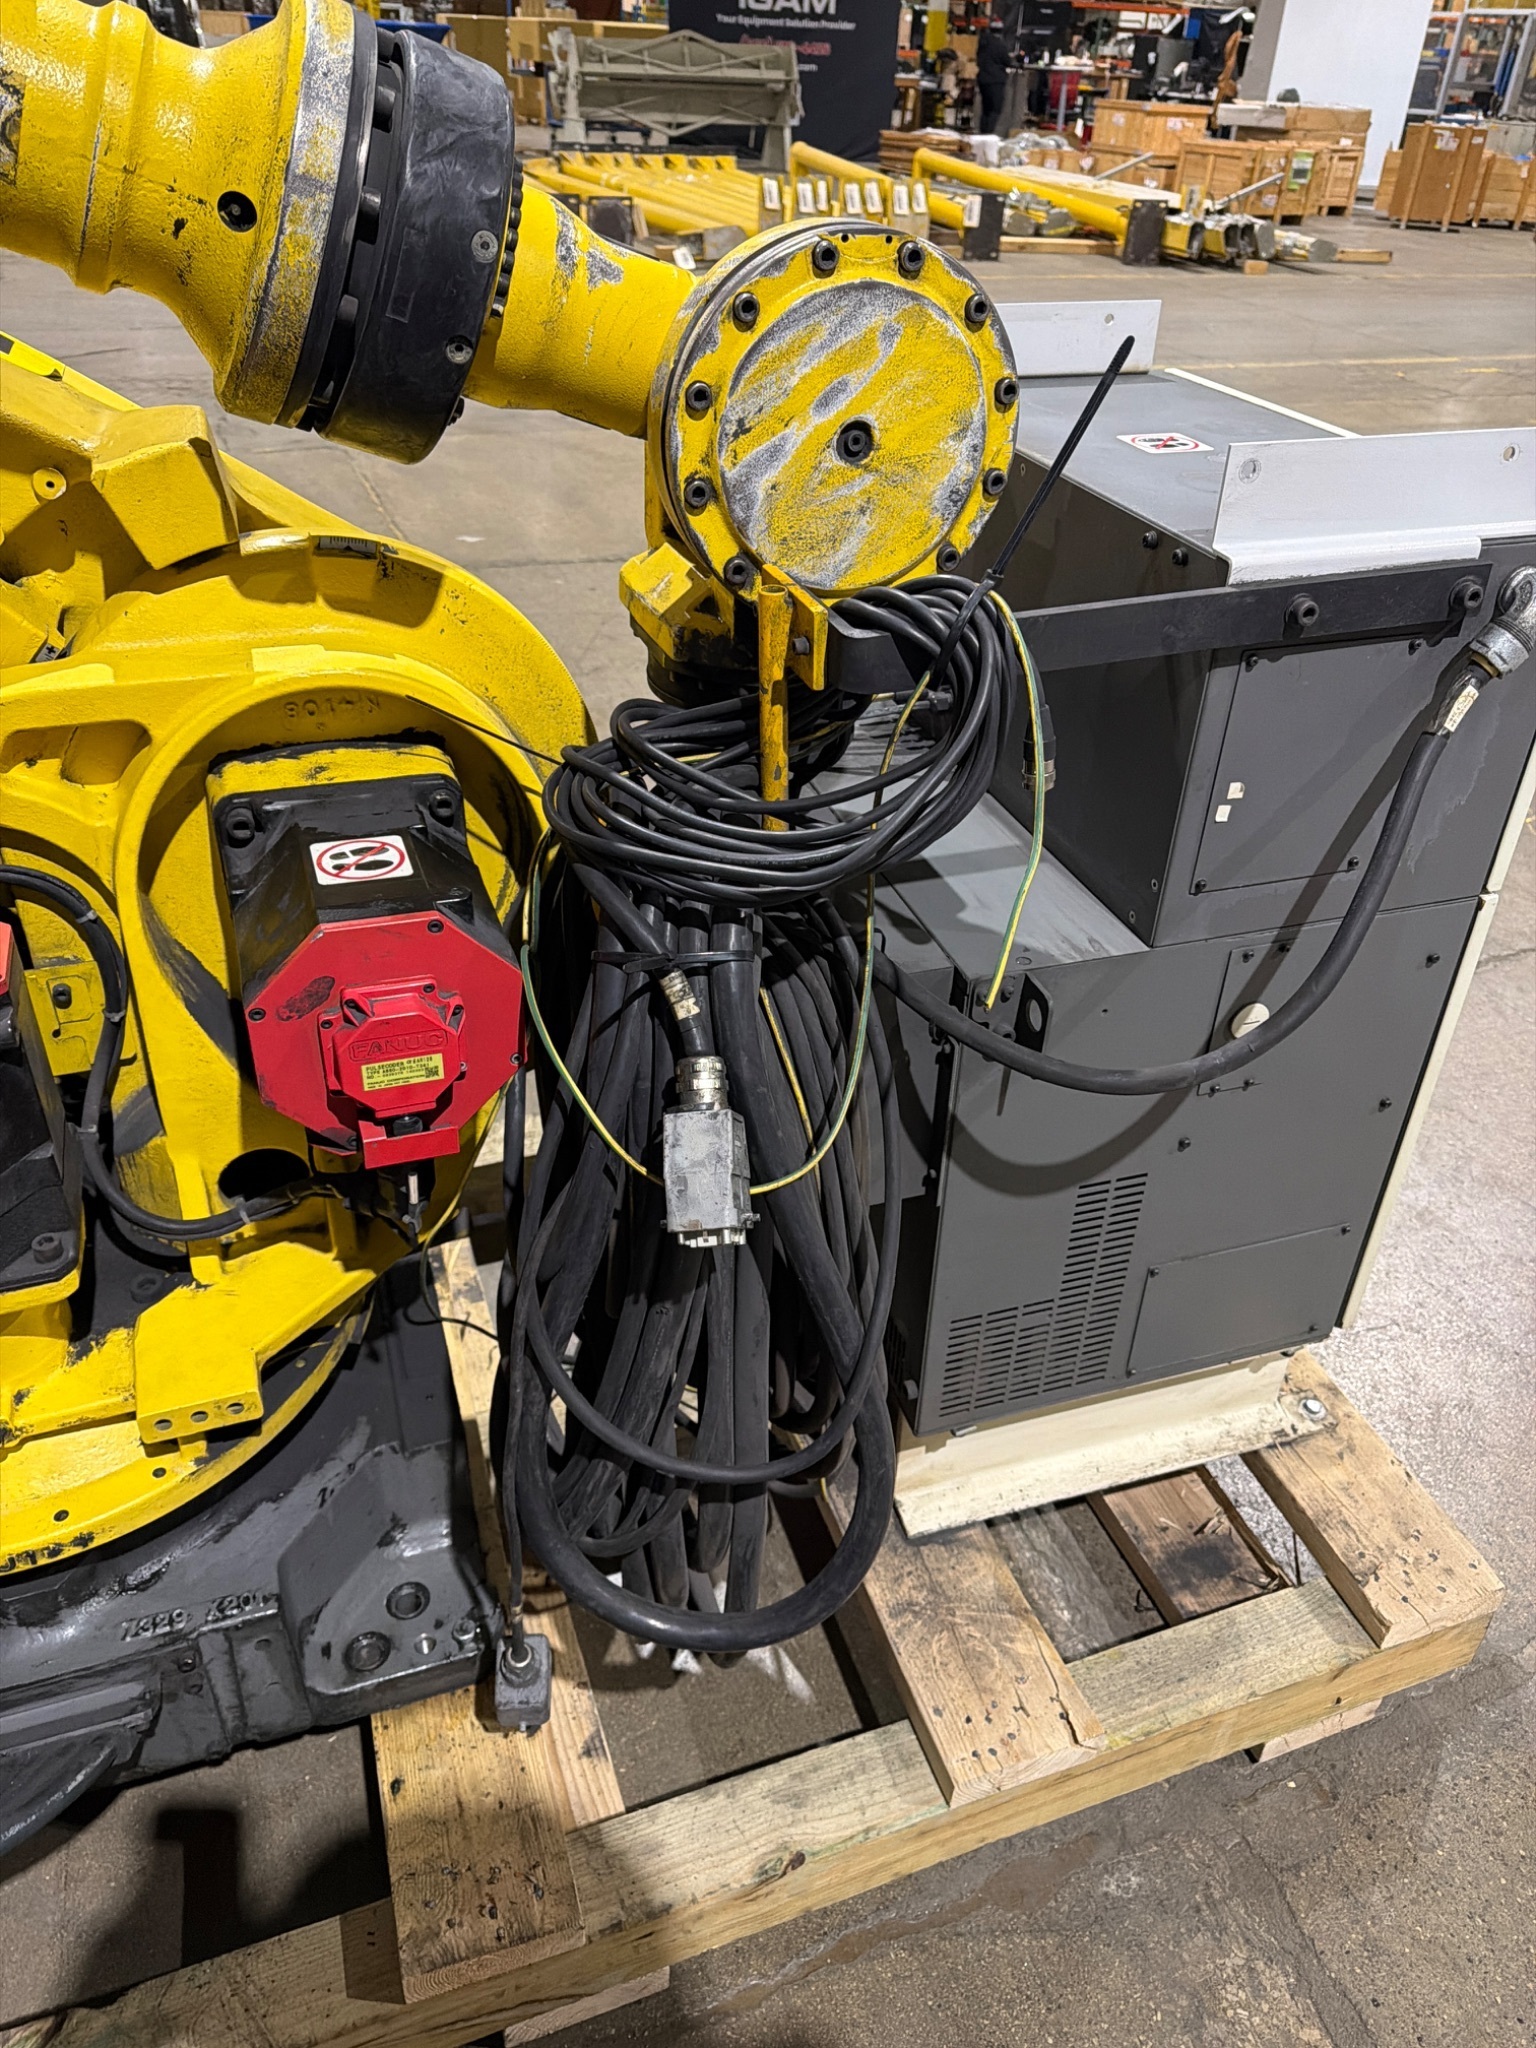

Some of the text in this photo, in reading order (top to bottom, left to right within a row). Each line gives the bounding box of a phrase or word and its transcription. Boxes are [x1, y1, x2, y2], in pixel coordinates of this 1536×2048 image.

[738, 14, 783, 28] Equipment
[785, 18, 818, 29] Solution
[820, 20, 856, 30] Provider
[351, 1033, 444, 1059] FANUC
[366, 1061, 404, 1071] PULSECODER
